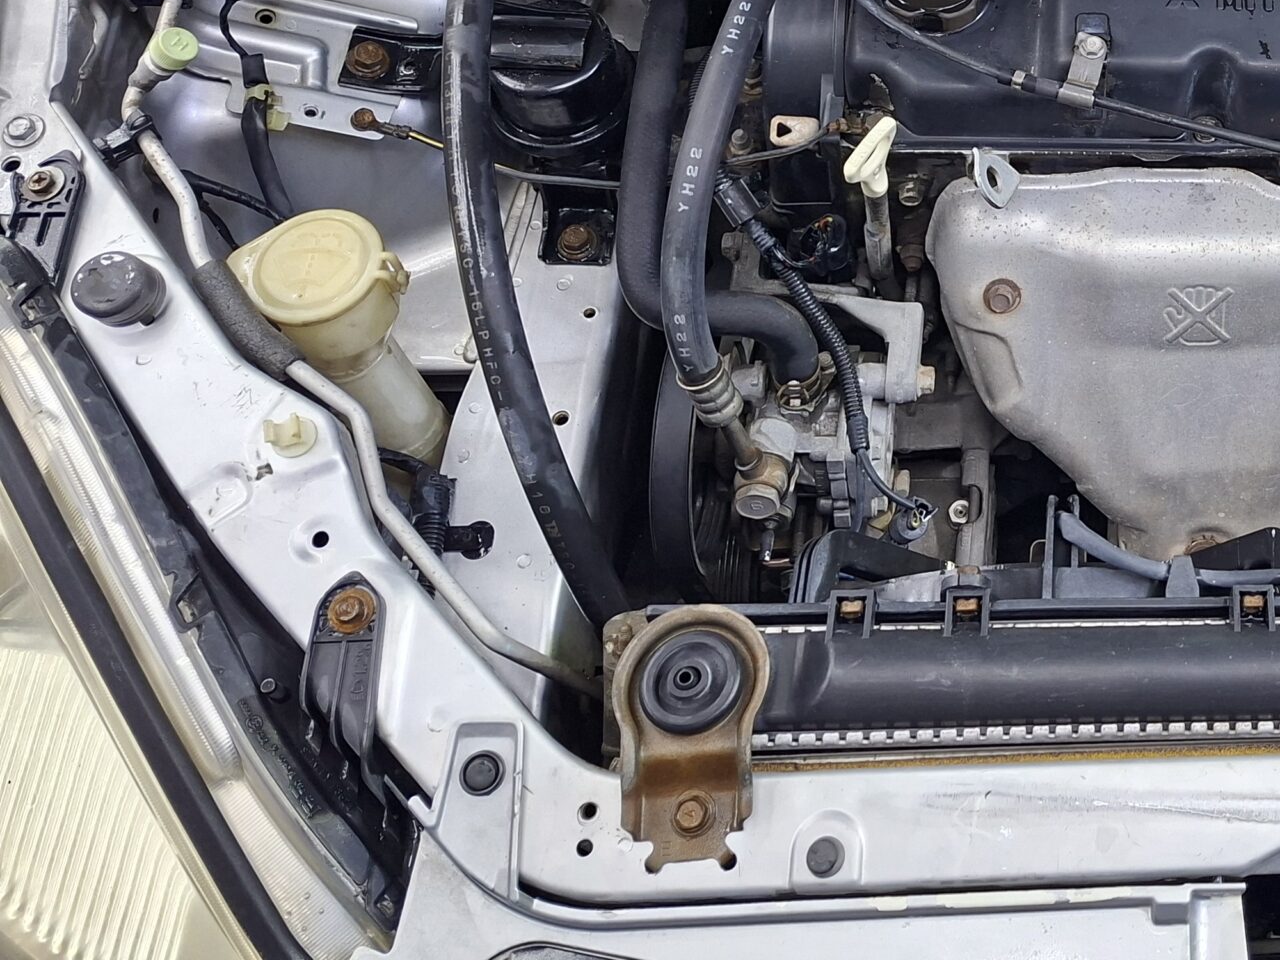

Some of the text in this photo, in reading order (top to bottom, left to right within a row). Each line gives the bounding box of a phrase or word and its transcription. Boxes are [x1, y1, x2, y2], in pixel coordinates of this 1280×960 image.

[720, 0, 753, 57] YH22
[676, 146, 705, 214] YH22
[673, 313, 695, 373] YH22
